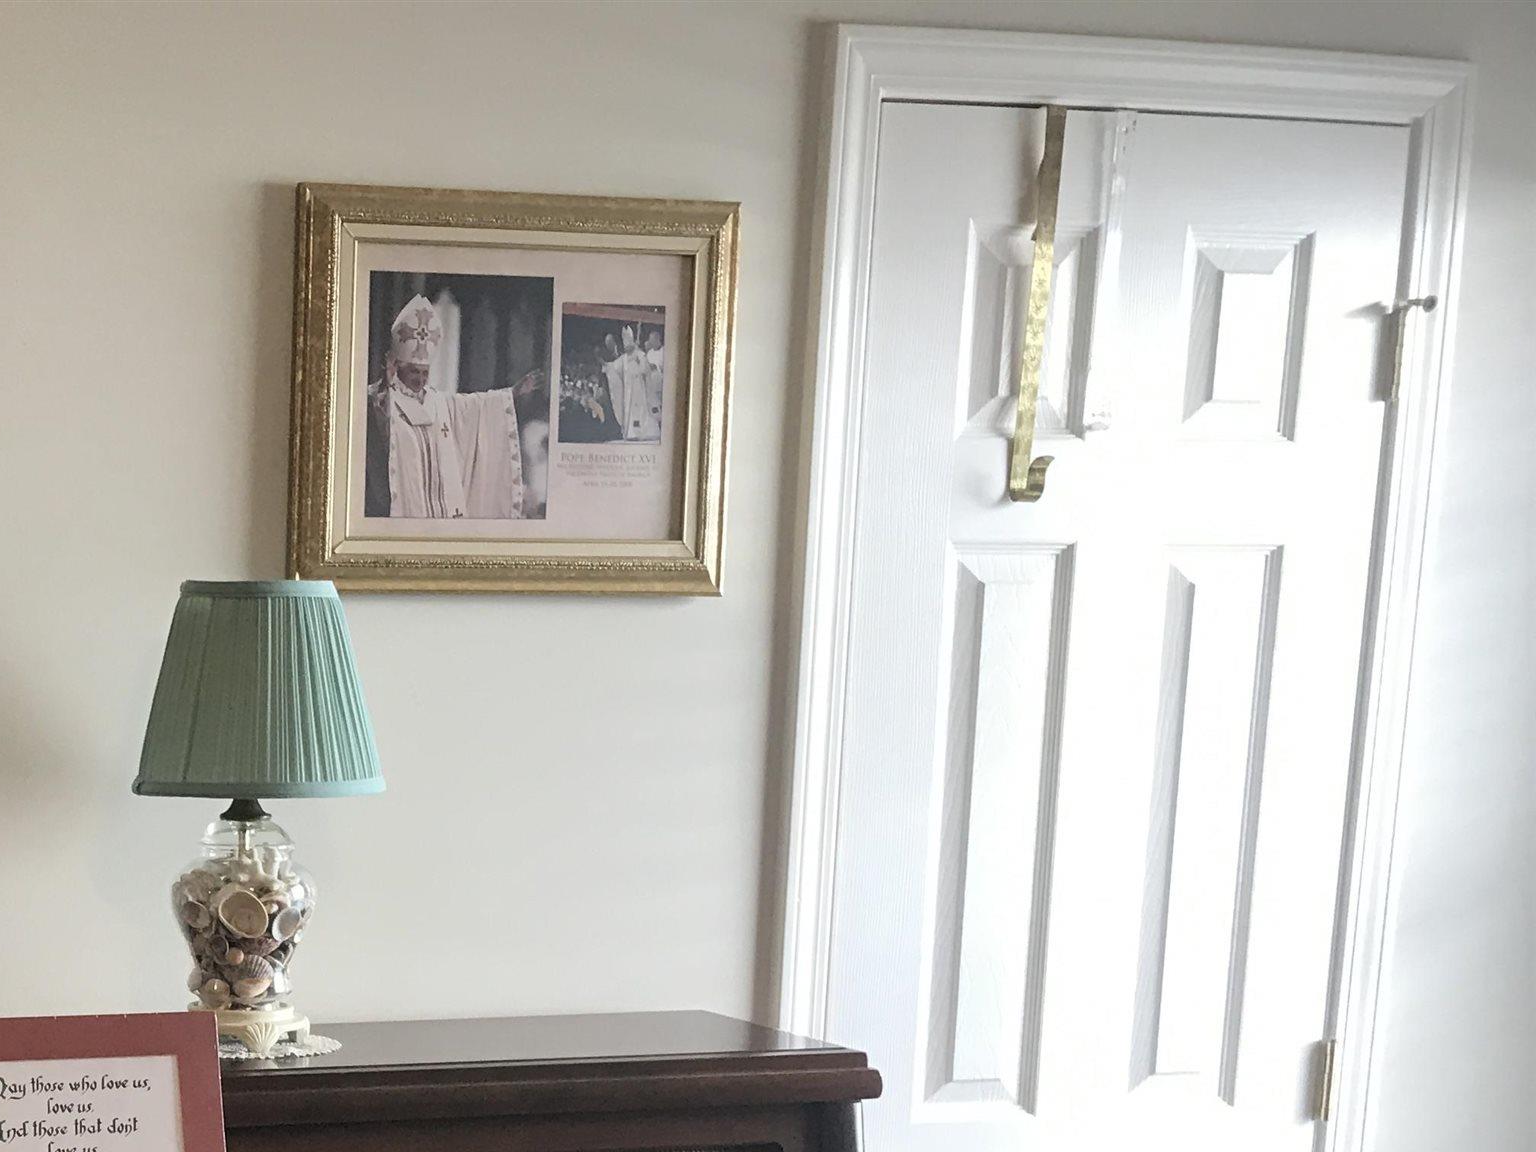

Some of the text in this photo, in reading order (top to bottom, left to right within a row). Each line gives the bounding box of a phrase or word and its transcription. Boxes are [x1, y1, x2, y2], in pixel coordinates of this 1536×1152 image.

[560, 452, 657, 465] POPE BENEDICT XVI
[30, 1075, 65, 1095] those
[68, 1075, 97, 1095] who
[101, 1074, 129, 1091] love
[132, 1077, 152, 1092] us,
[47, 1097, 74, 1115] love
[32, 1120, 68, 1141] those
[74, 1118, 103, 1136] that
[106, 1116, 139, 1137] don't
